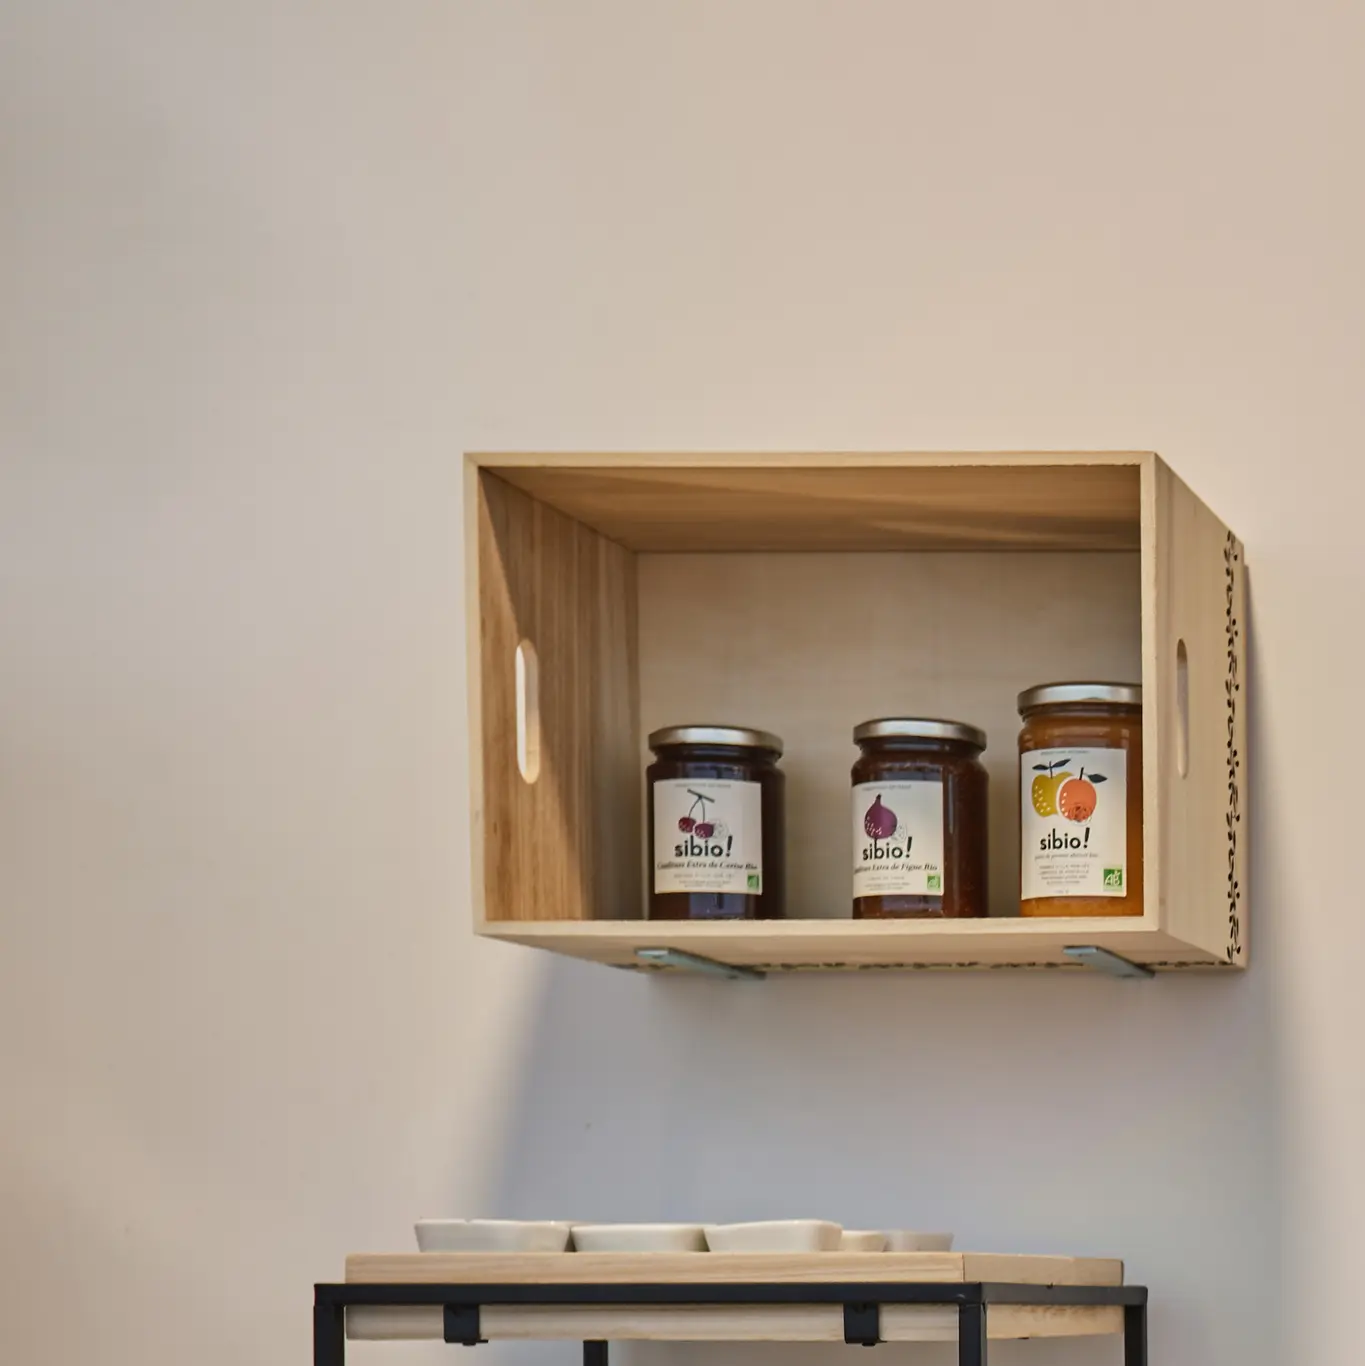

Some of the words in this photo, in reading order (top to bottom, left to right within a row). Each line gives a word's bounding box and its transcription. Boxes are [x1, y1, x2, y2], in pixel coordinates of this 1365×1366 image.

[674, 835, 733, 857] sibio!
[862, 836, 913, 860] sibio!
[1040, 827, 1090, 851] sibio!
